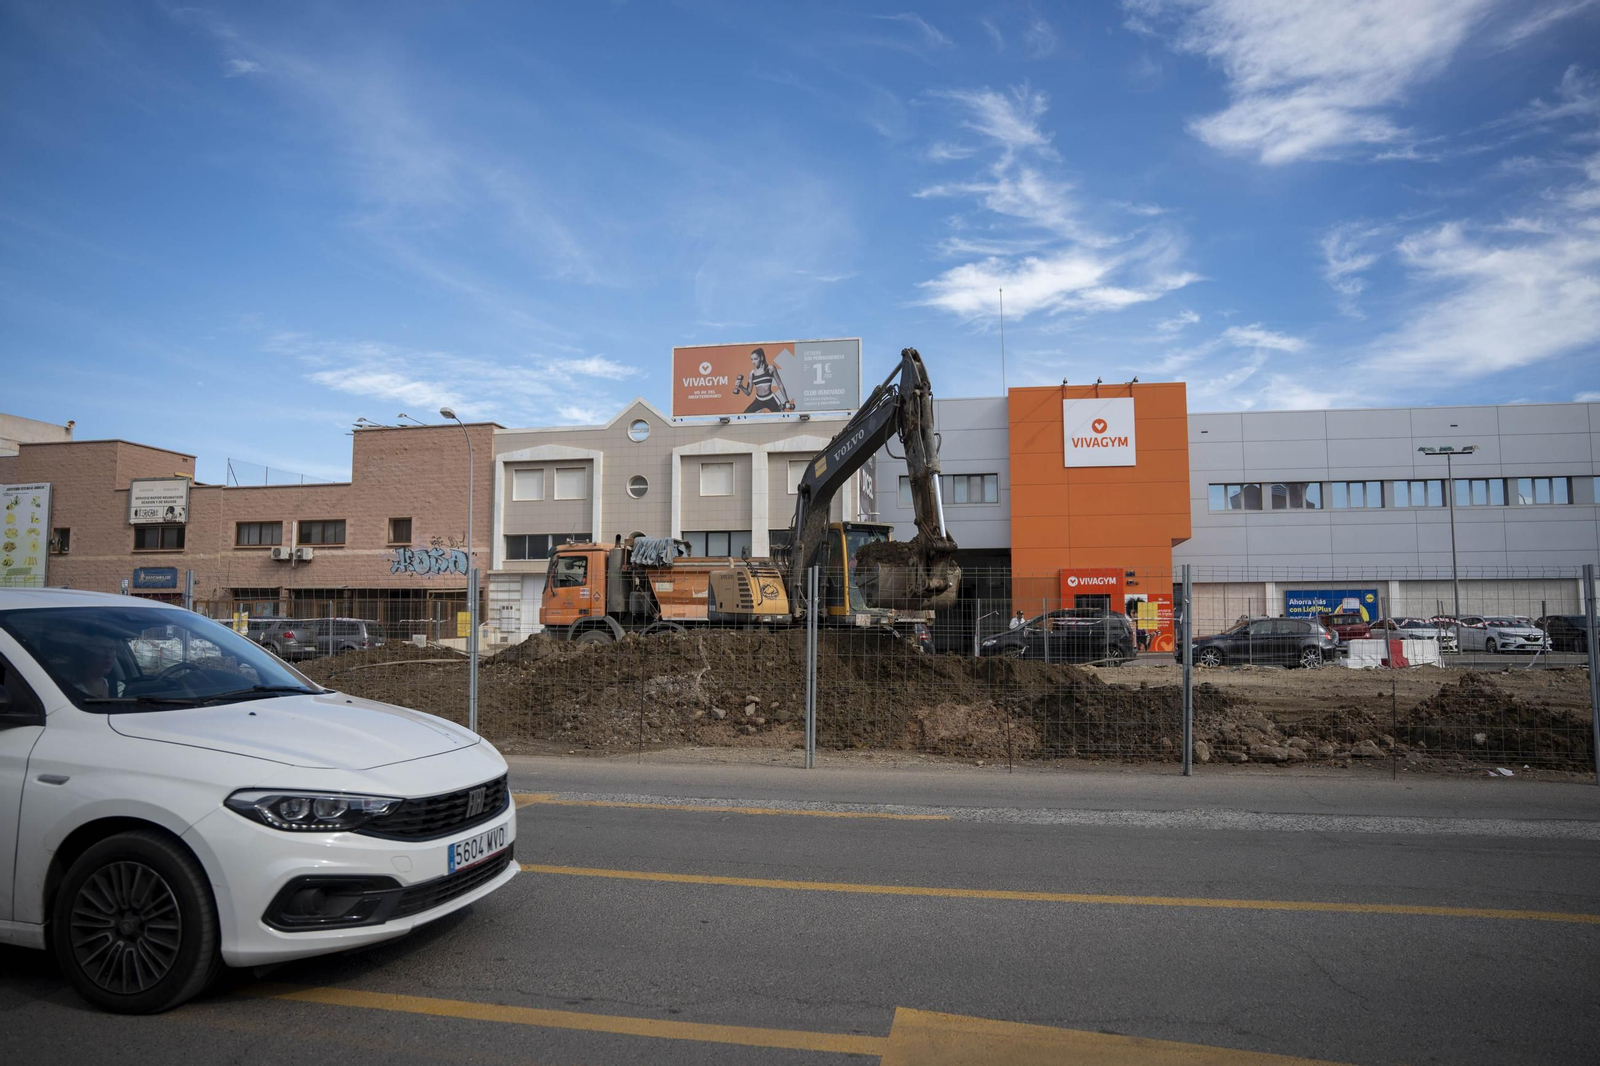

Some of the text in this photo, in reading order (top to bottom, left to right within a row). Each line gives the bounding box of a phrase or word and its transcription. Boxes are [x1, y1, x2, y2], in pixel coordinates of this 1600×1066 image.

[682, 375, 728, 387] VIVAGYM
[833, 429, 865, 462] VOLVO
[1071, 436, 1129, 448] VIVAGYM
[1079, 577, 1117, 585] VIVAGYM
[455, 827, 505, 866] 5604 MVD
